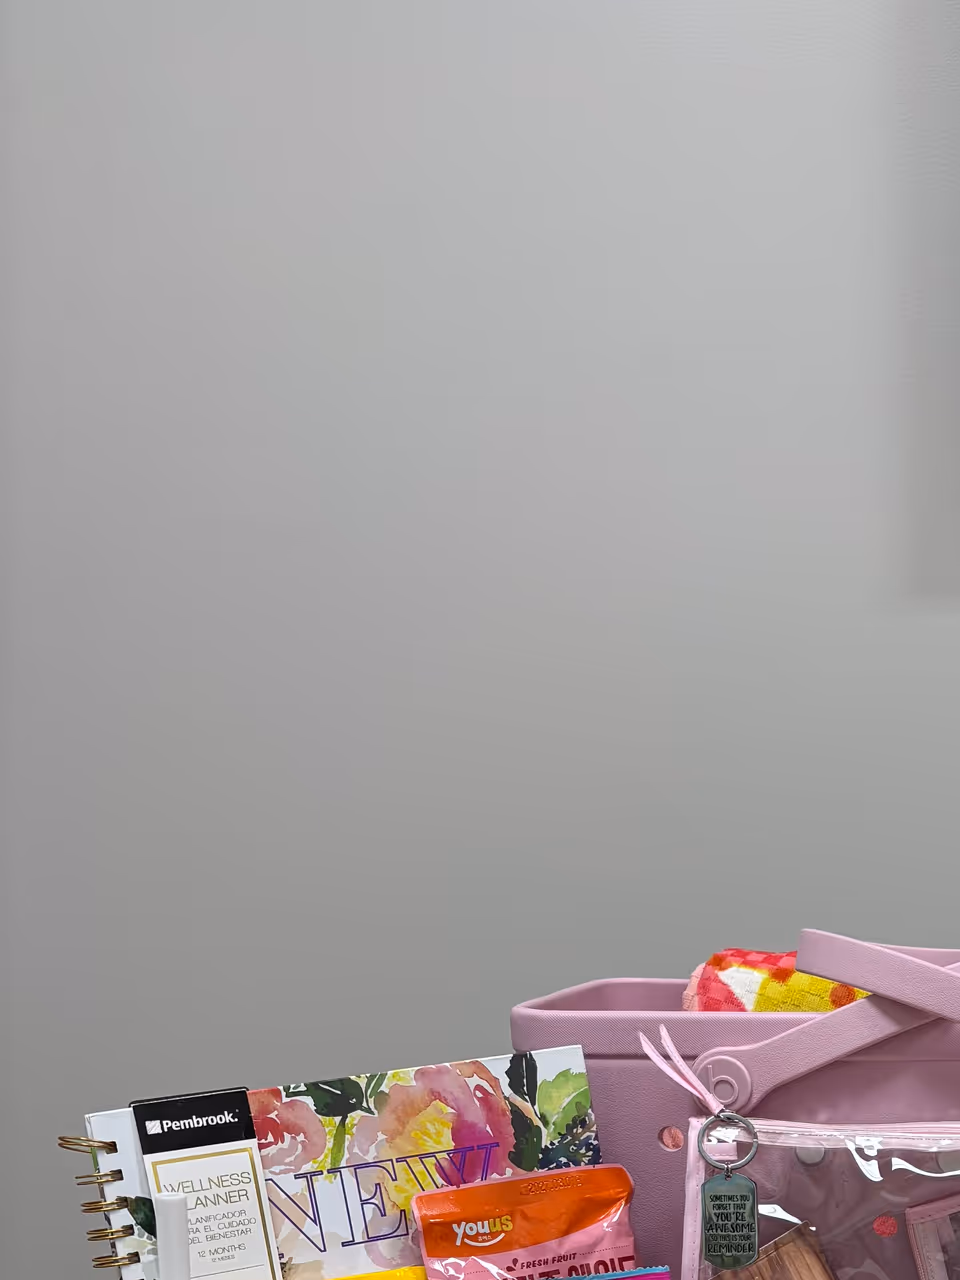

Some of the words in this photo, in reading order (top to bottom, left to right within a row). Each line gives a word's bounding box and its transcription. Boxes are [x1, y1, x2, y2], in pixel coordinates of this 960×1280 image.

[163, 1171, 253, 1195] WELLNESS
[186, 1188, 250, 1211] ANNER
[709, 1193, 739, 1203] SOMETIMES
[739, 1193, 751, 1203] YOU
[712, 1203, 732, 1211] FORGET
[732, 1203, 746, 1211] THAT
[187, 1209, 248, 1225] LANIFICADOR
[203, 1224, 216, 1233] EL
[217, 1216, 257, 1232] CUIDADO
[713, 1211, 747, 1223] YOU'RE
[205, 1227, 252, 1244] BIENESTAR
[452, 1214, 514, 1247] youus
[705, 1222, 756, 1234] AWESOME
[718, 1234, 731, 1242] THIS
[738, 1234, 752, 1242] YOUR
[197, 1250, 206, 1259] 12
[208, 1242, 247, 1258] MONTHS
[707, 1243, 755, 1254] REMINDER
[520, 1257, 549, 1270] FRESH
[551, 1252, 578, 1266] FRUIT
